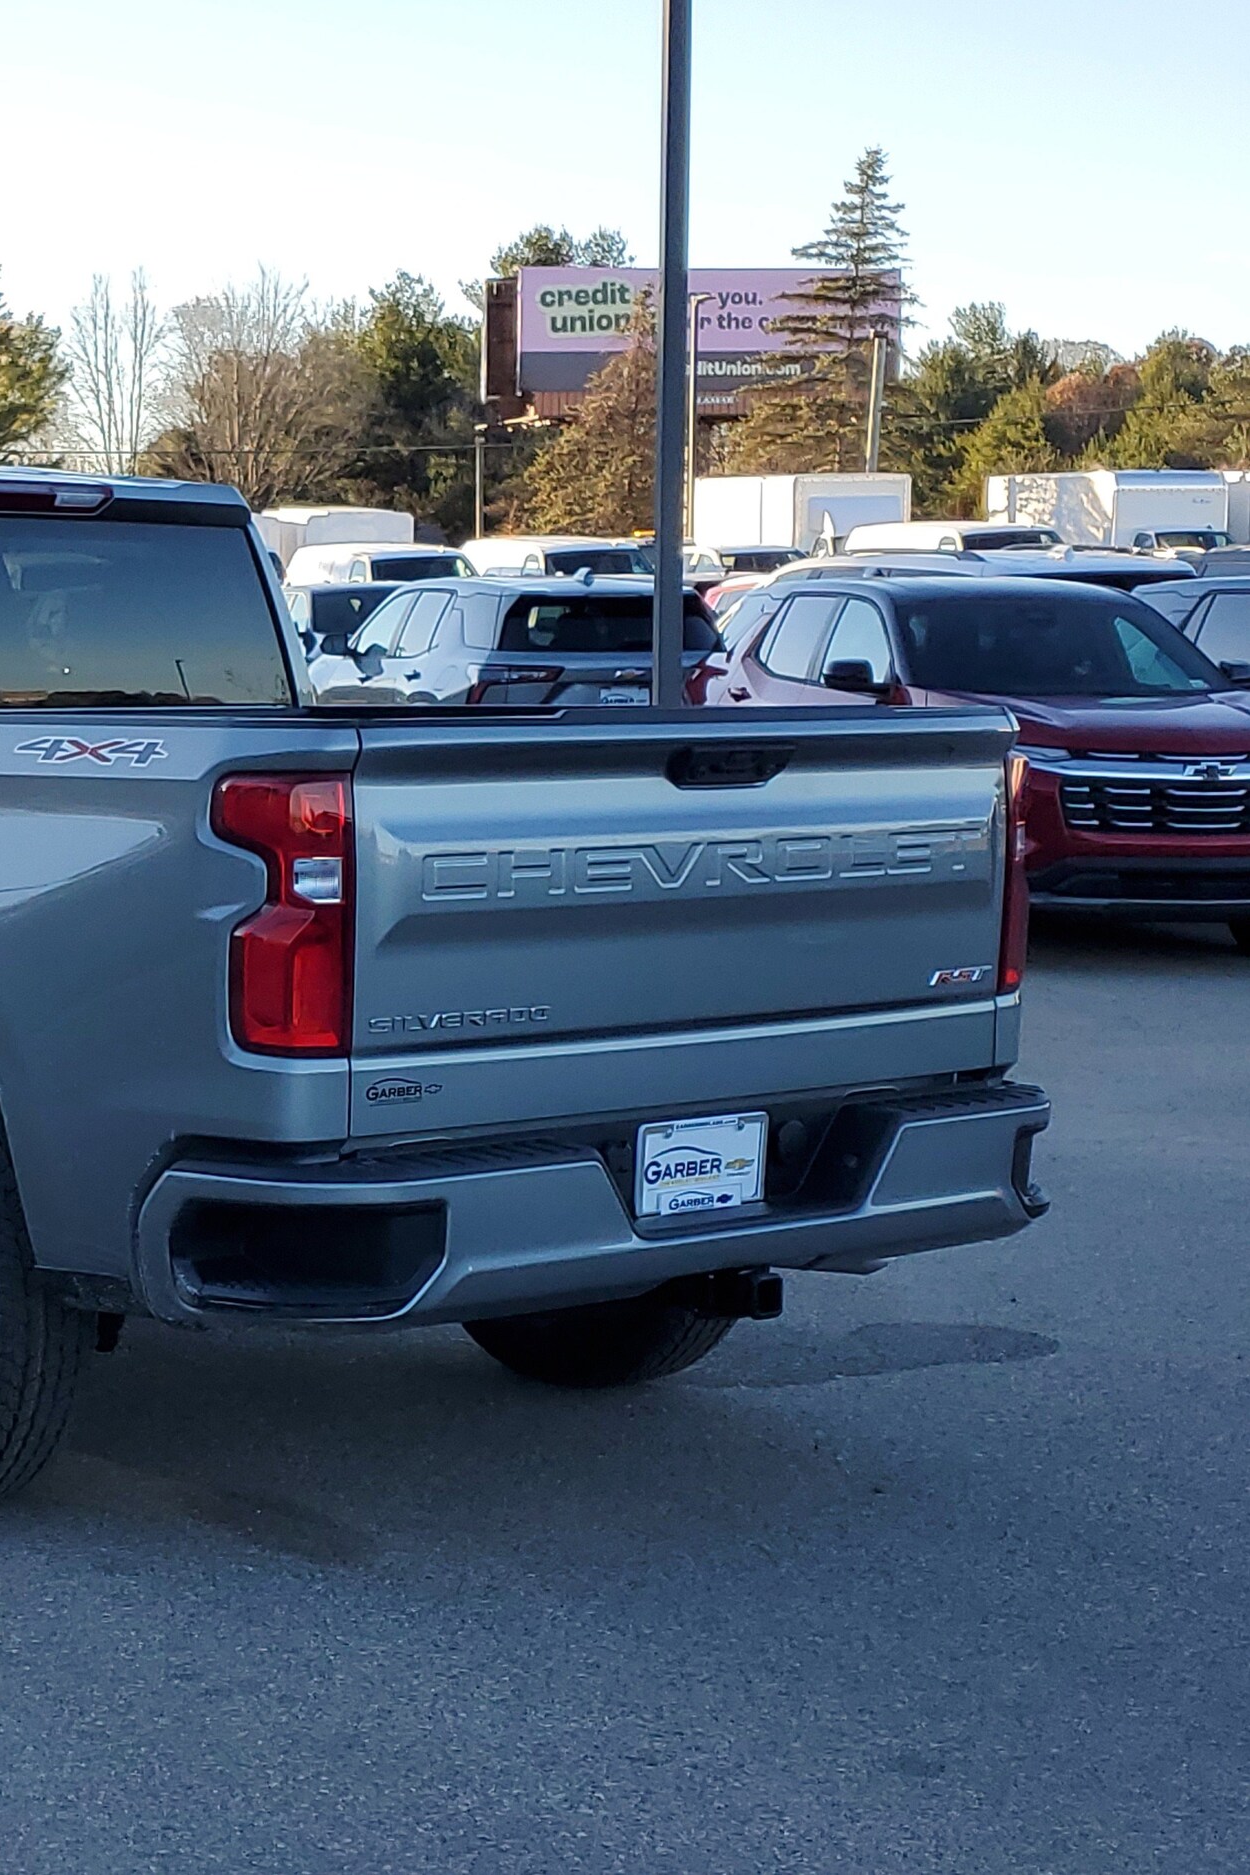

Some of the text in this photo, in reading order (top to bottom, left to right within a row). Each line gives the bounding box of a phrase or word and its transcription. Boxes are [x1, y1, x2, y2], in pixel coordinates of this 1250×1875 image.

[540, 282, 630, 307] credit
[718, 291, 763, 309] you.
[551, 309, 631, 333] union
[717, 312, 753, 330] the
[422, 825, 983, 901] CHEVROLET
[929, 965, 993, 986] RST
[368, 1005, 551, 1033] SILVERADO
[366, 1085, 422, 1101] GARBER
[644, 1158, 722, 1185] GARBER
[669, 1196, 714, 1211] GARBER
